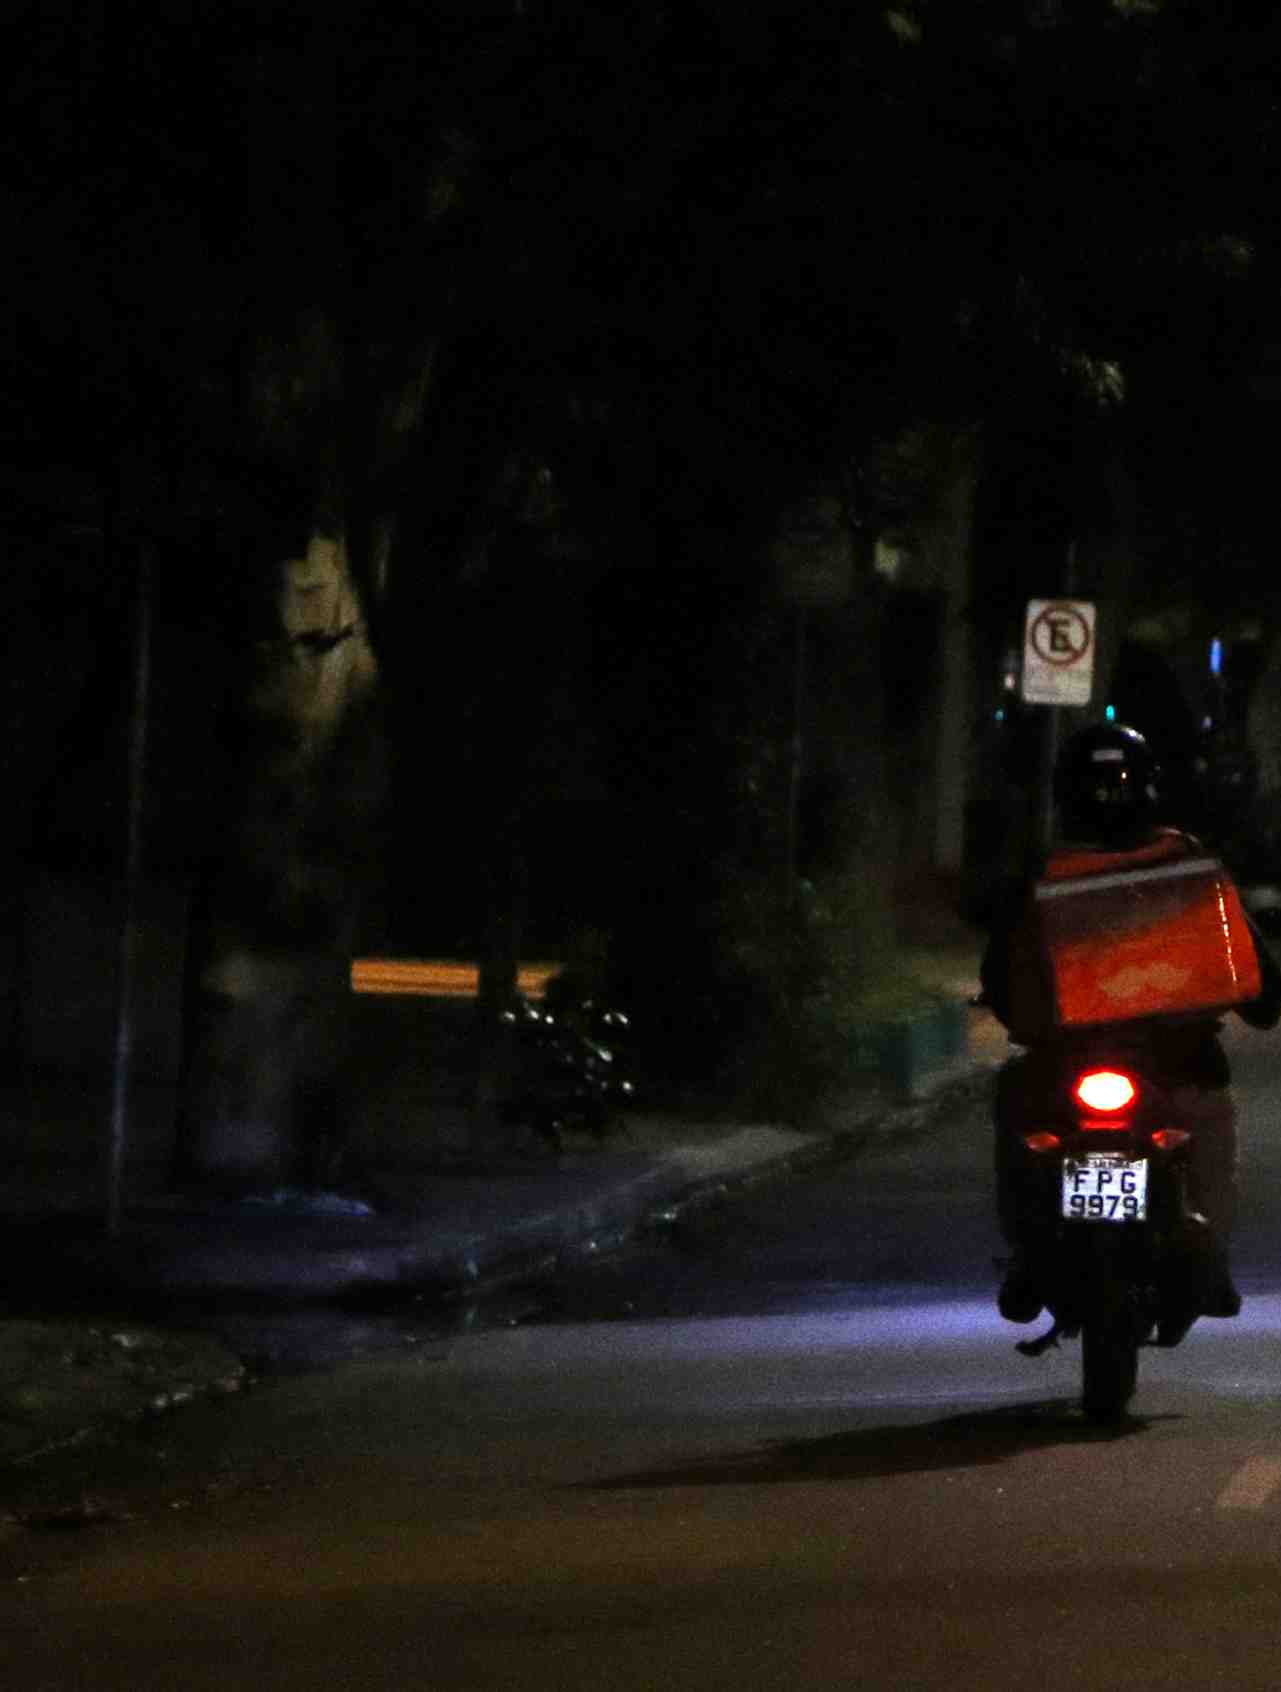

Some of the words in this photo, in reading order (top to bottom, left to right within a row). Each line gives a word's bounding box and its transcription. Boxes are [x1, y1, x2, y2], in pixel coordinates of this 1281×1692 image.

[1050, 618, 1072, 652] E
[1074, 1170, 1136, 1194] FPG
[1070, 1194, 1138, 1217] 9979
